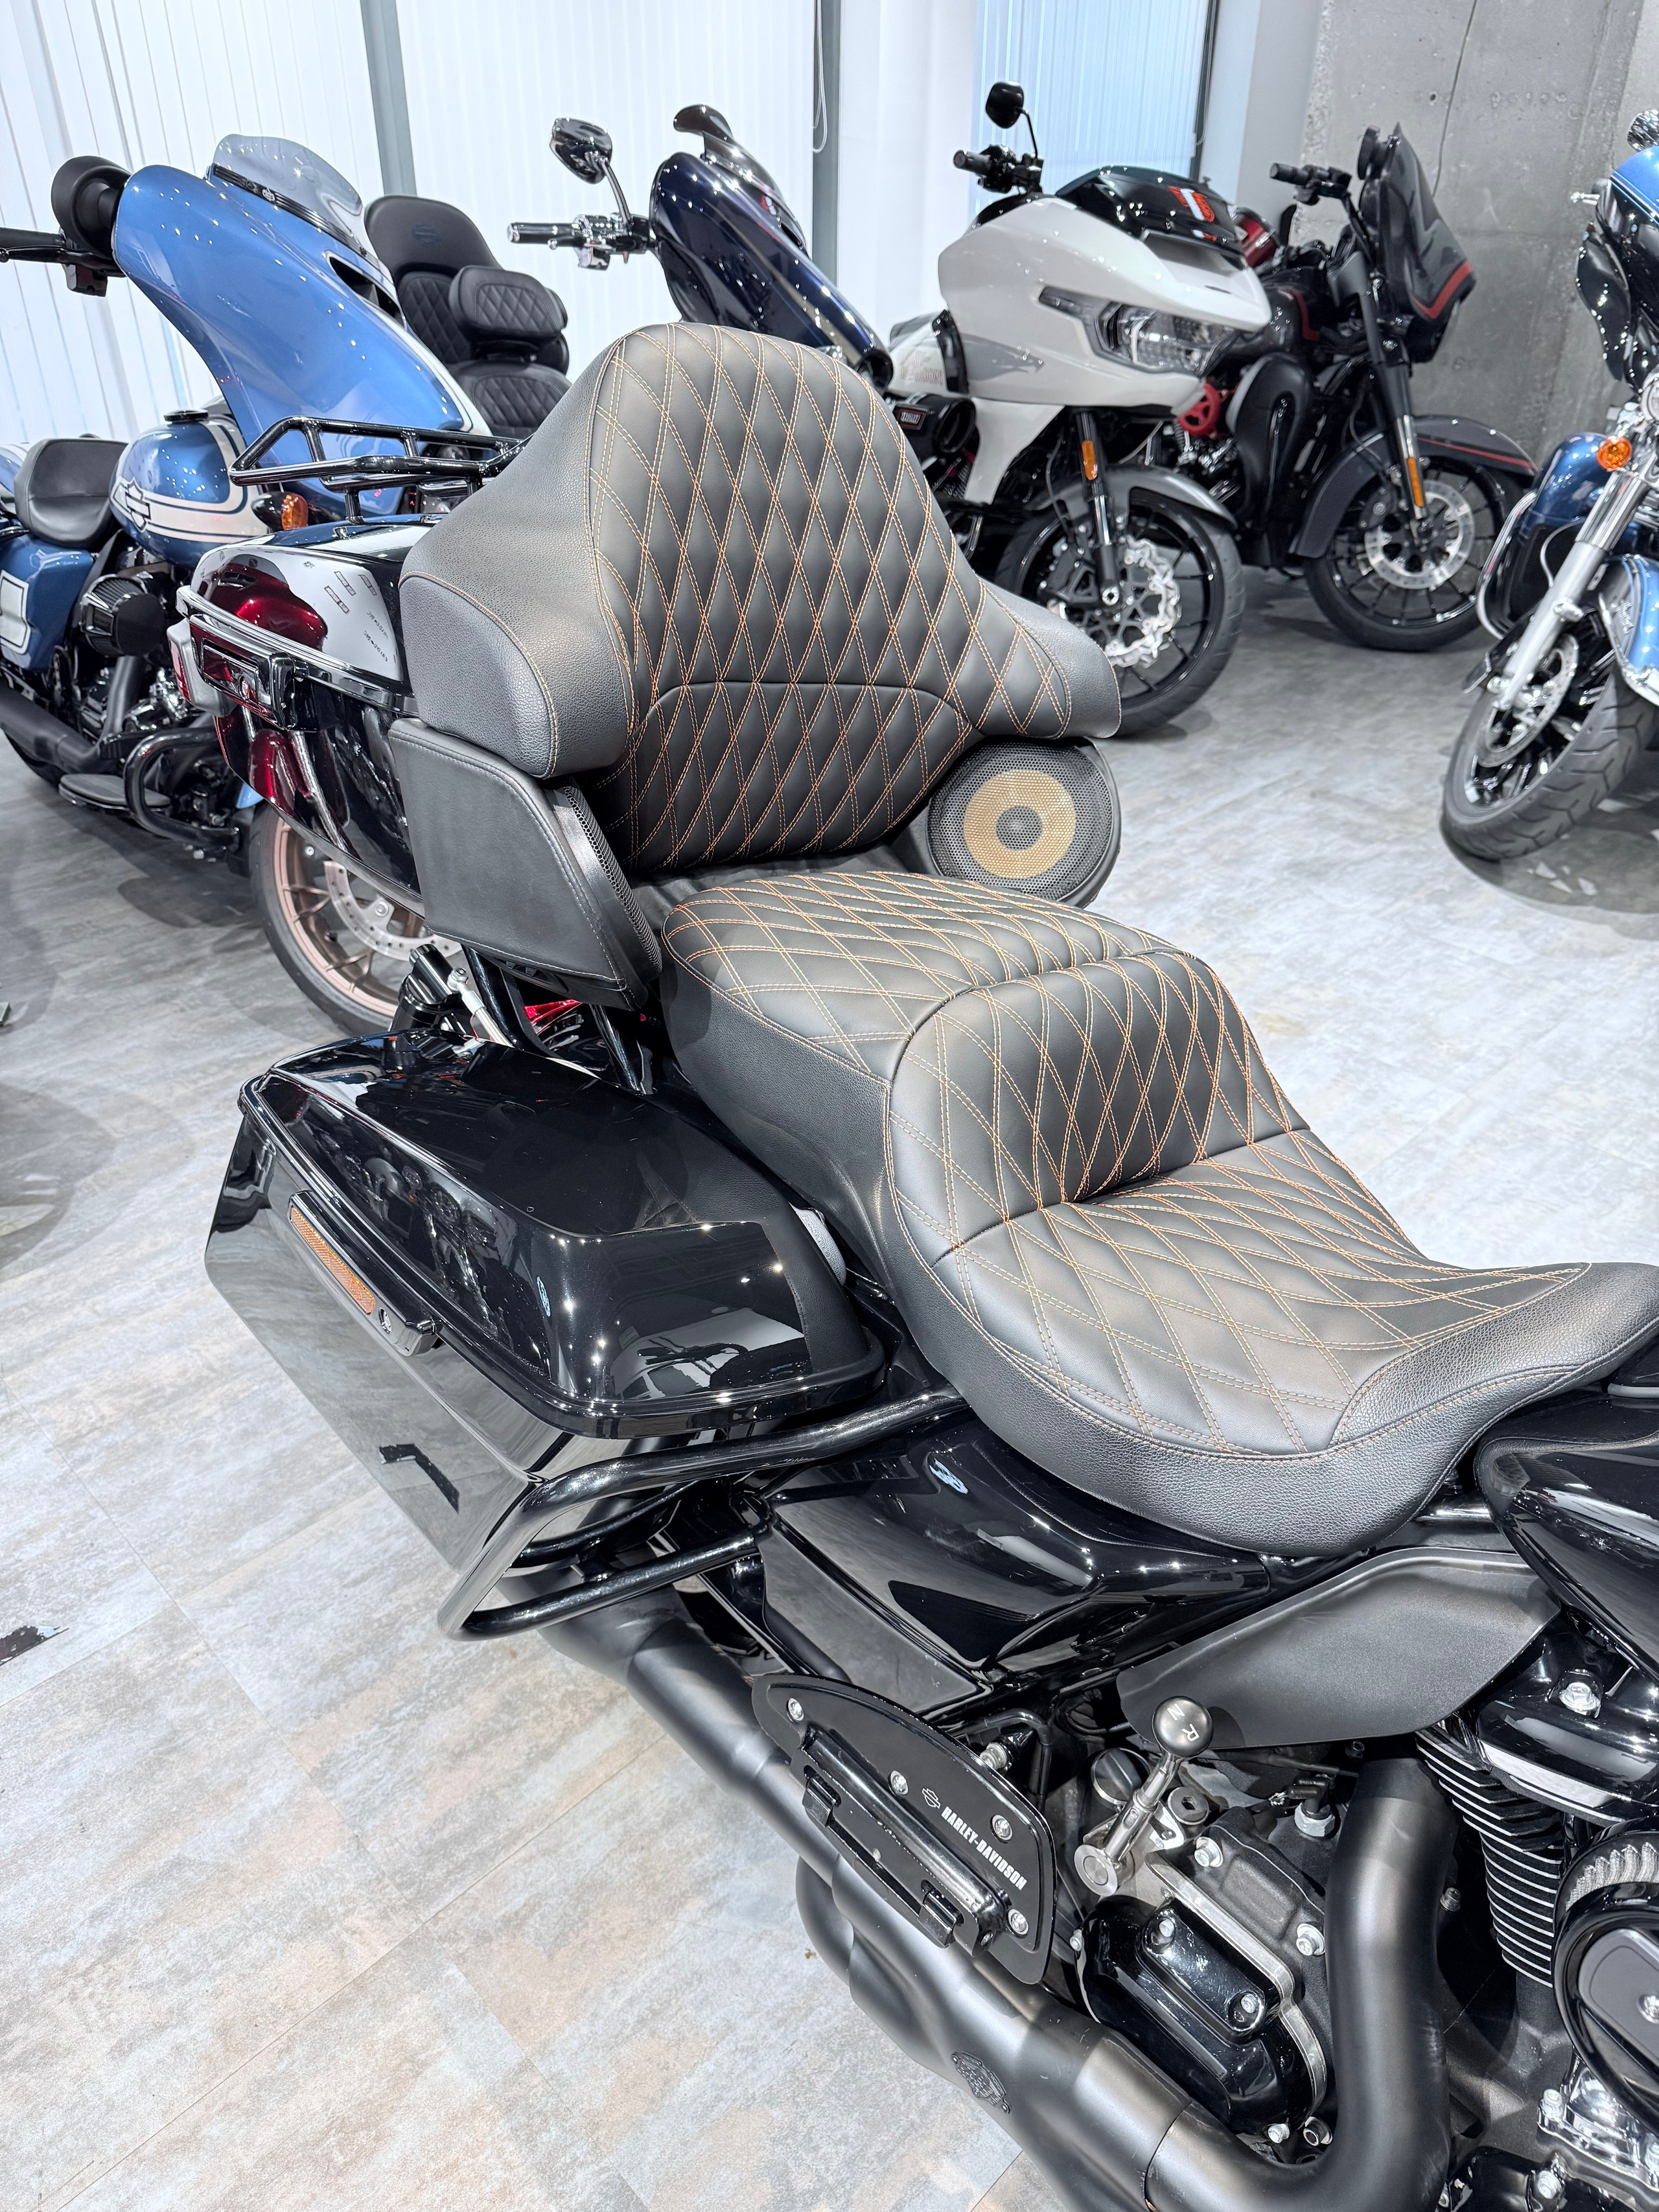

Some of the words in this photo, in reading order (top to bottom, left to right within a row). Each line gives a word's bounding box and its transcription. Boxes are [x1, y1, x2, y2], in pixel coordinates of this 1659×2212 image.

[900, 364, 944, 386] DDSON
[1166, 1703, 1185, 1721] N
[1181, 1723, 1200, 1741] R
[941, 1806, 1028, 1891] HARLEY-DAVIDSON
